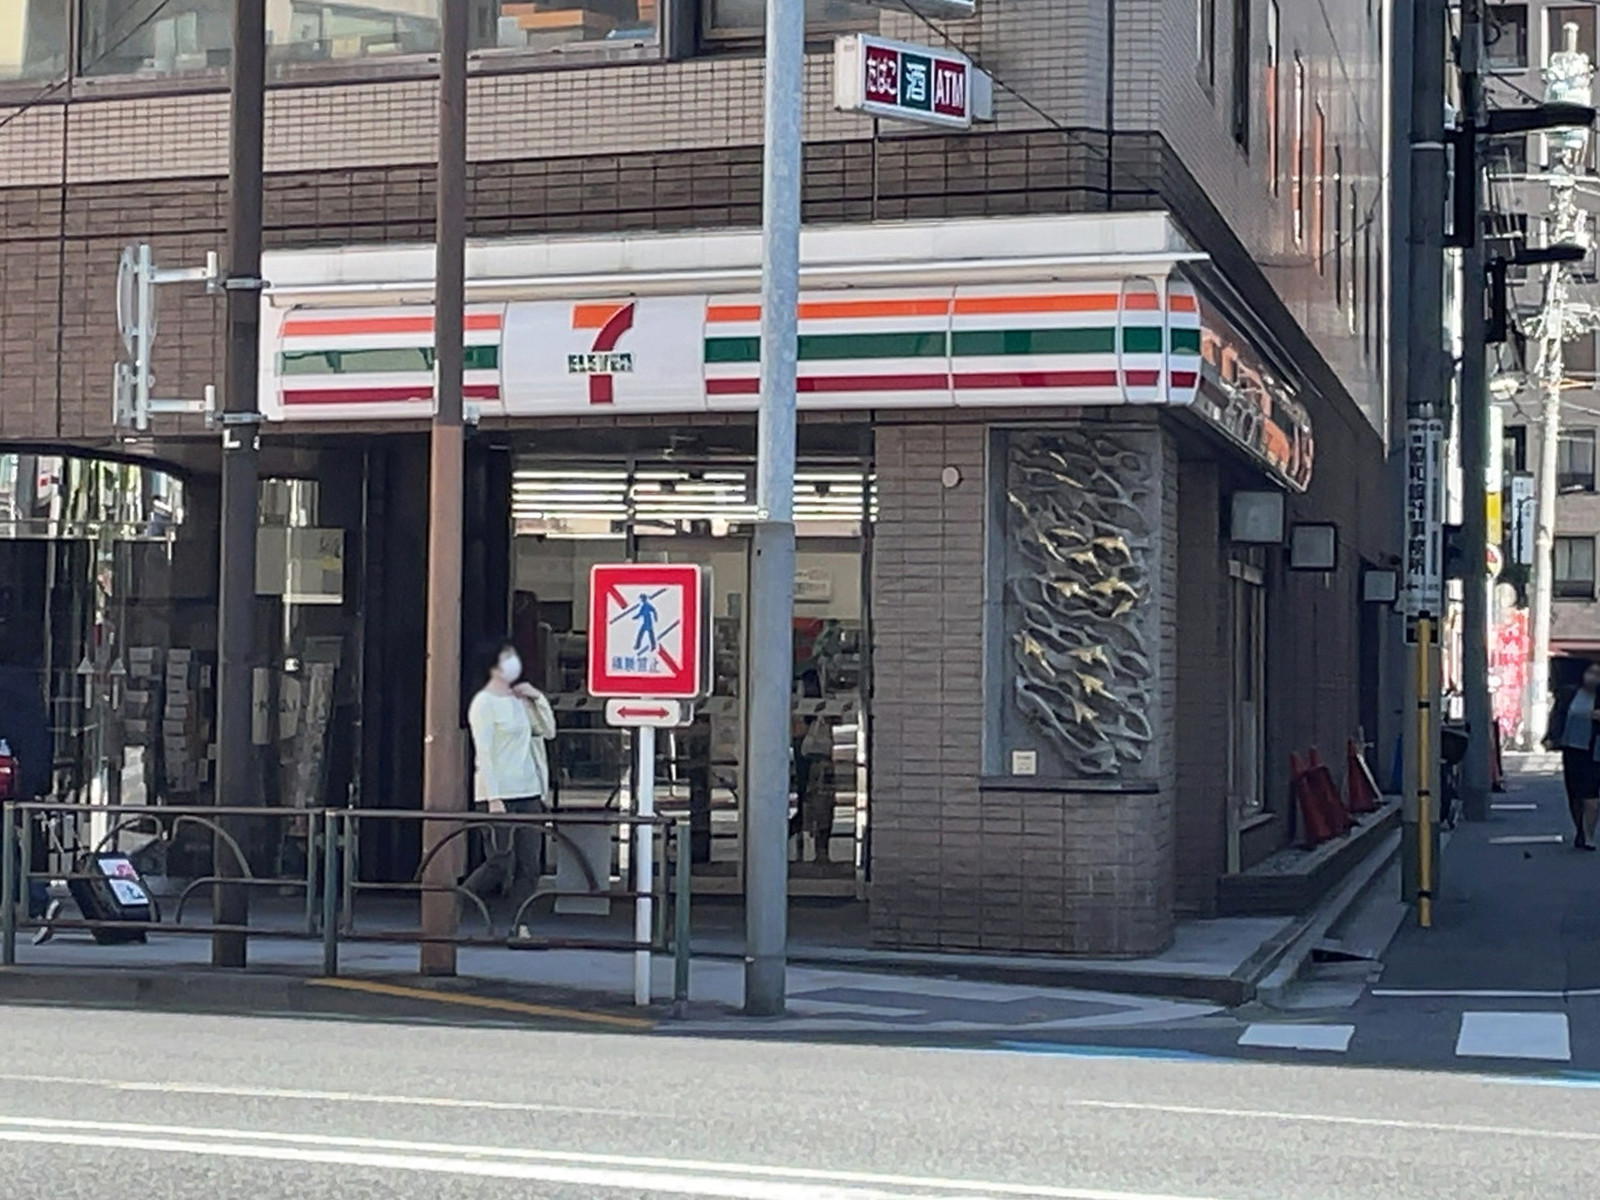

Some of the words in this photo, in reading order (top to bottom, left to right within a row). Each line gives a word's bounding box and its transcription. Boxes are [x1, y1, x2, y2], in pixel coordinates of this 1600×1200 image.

[906, 62, 927, 102] 酒
[935, 68, 965, 108] ATM
[572, 302, 635, 404] 7
